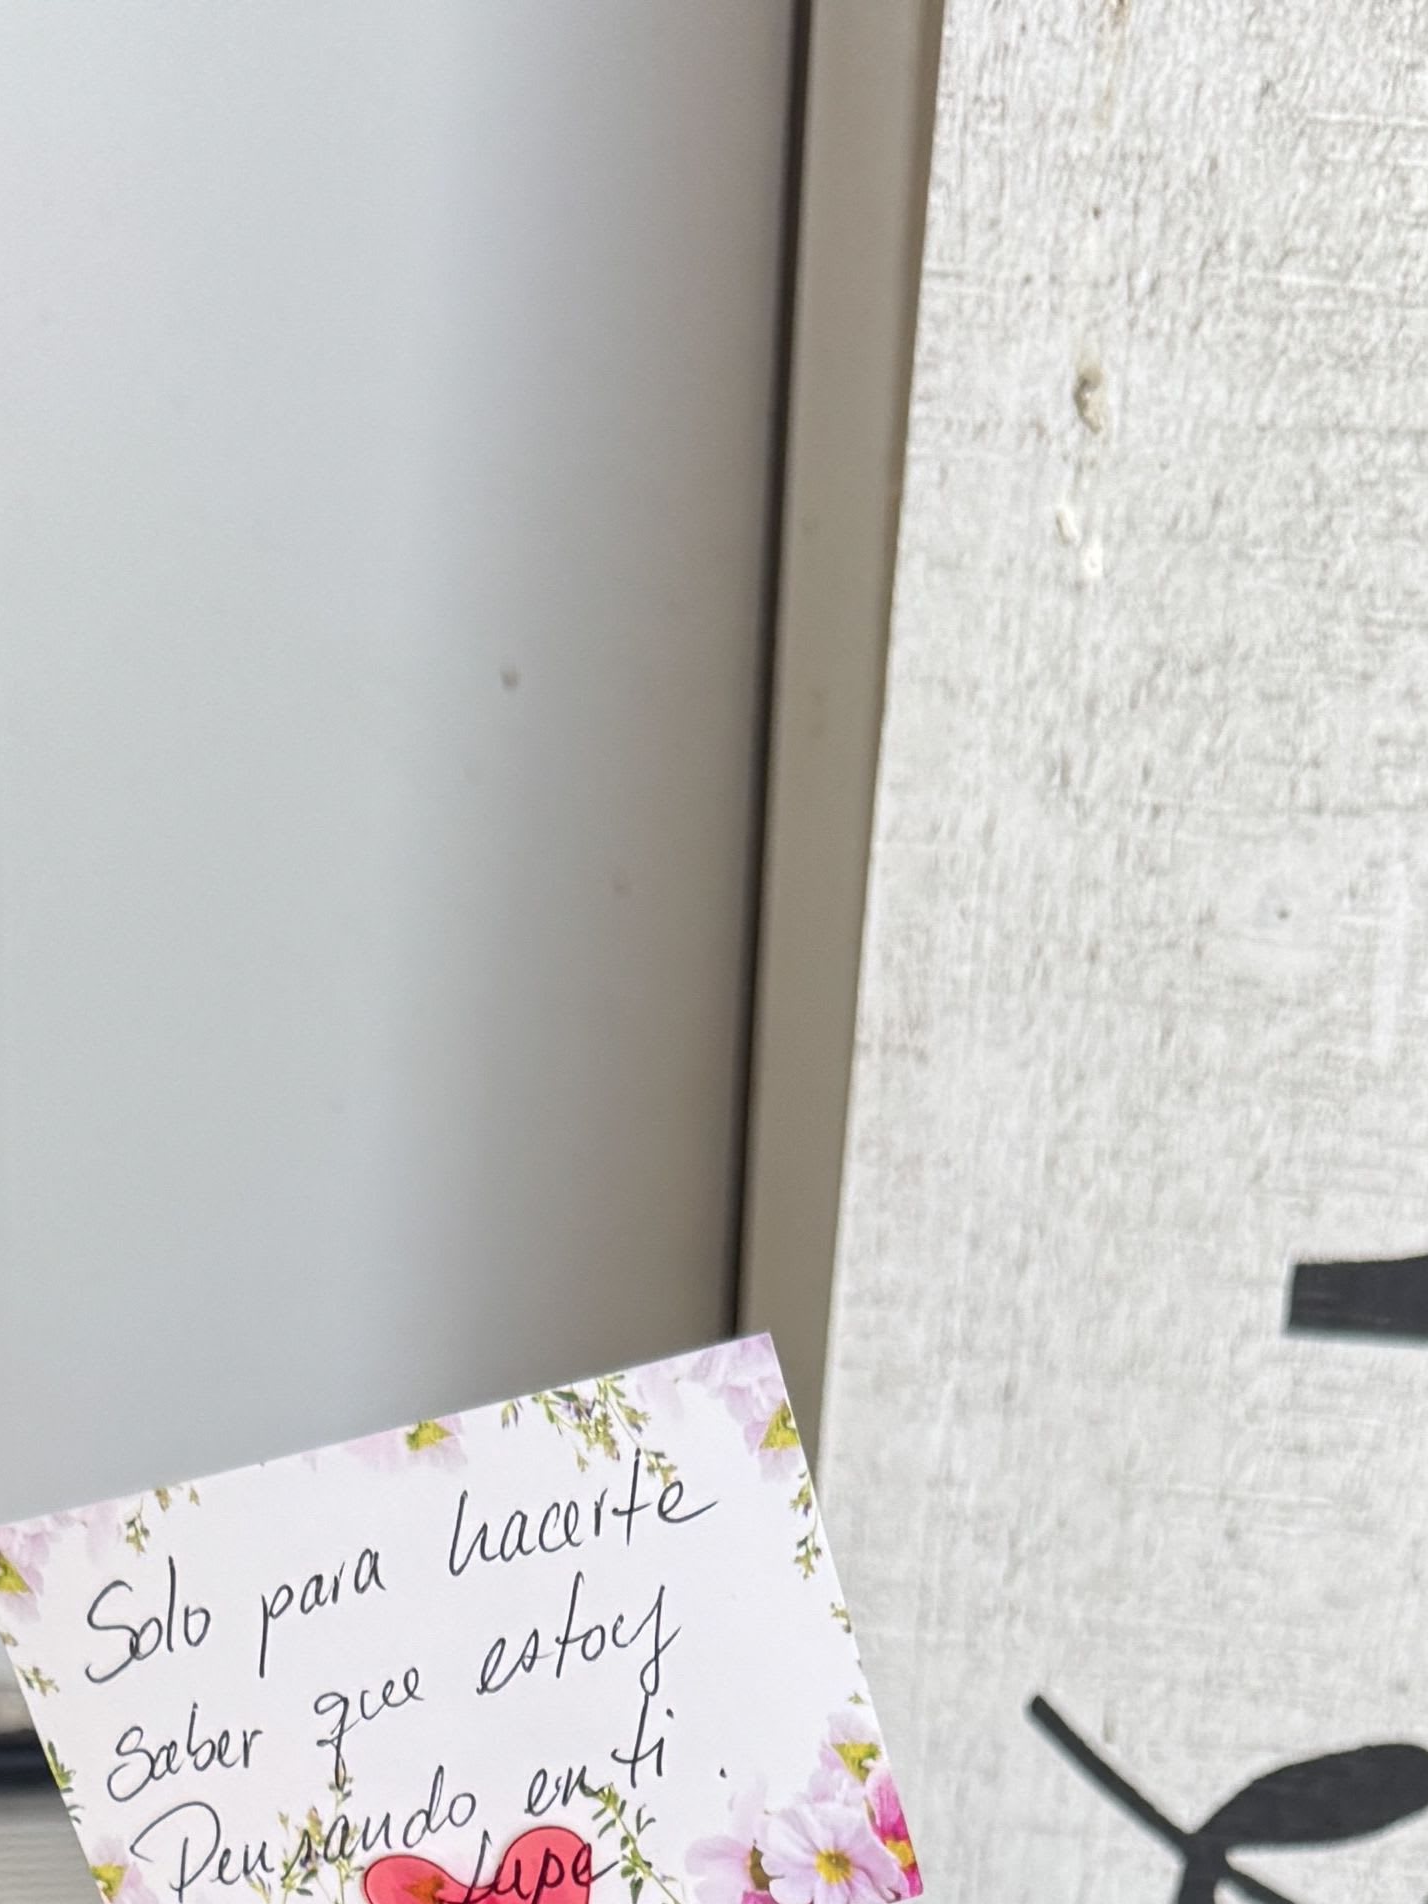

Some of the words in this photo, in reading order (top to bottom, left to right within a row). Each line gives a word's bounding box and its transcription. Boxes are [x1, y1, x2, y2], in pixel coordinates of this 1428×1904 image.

[85, 1557, 212, 1684] Solo
[258, 1545, 385, 1680] para
[449, 1447, 722, 1577] hacerte
[105, 1702, 265, 1803] Saber
[312, 1664, 426, 1789] que
[476, 1570, 682, 1697] estoy
[129, 1763, 478, 1902] Pensando
